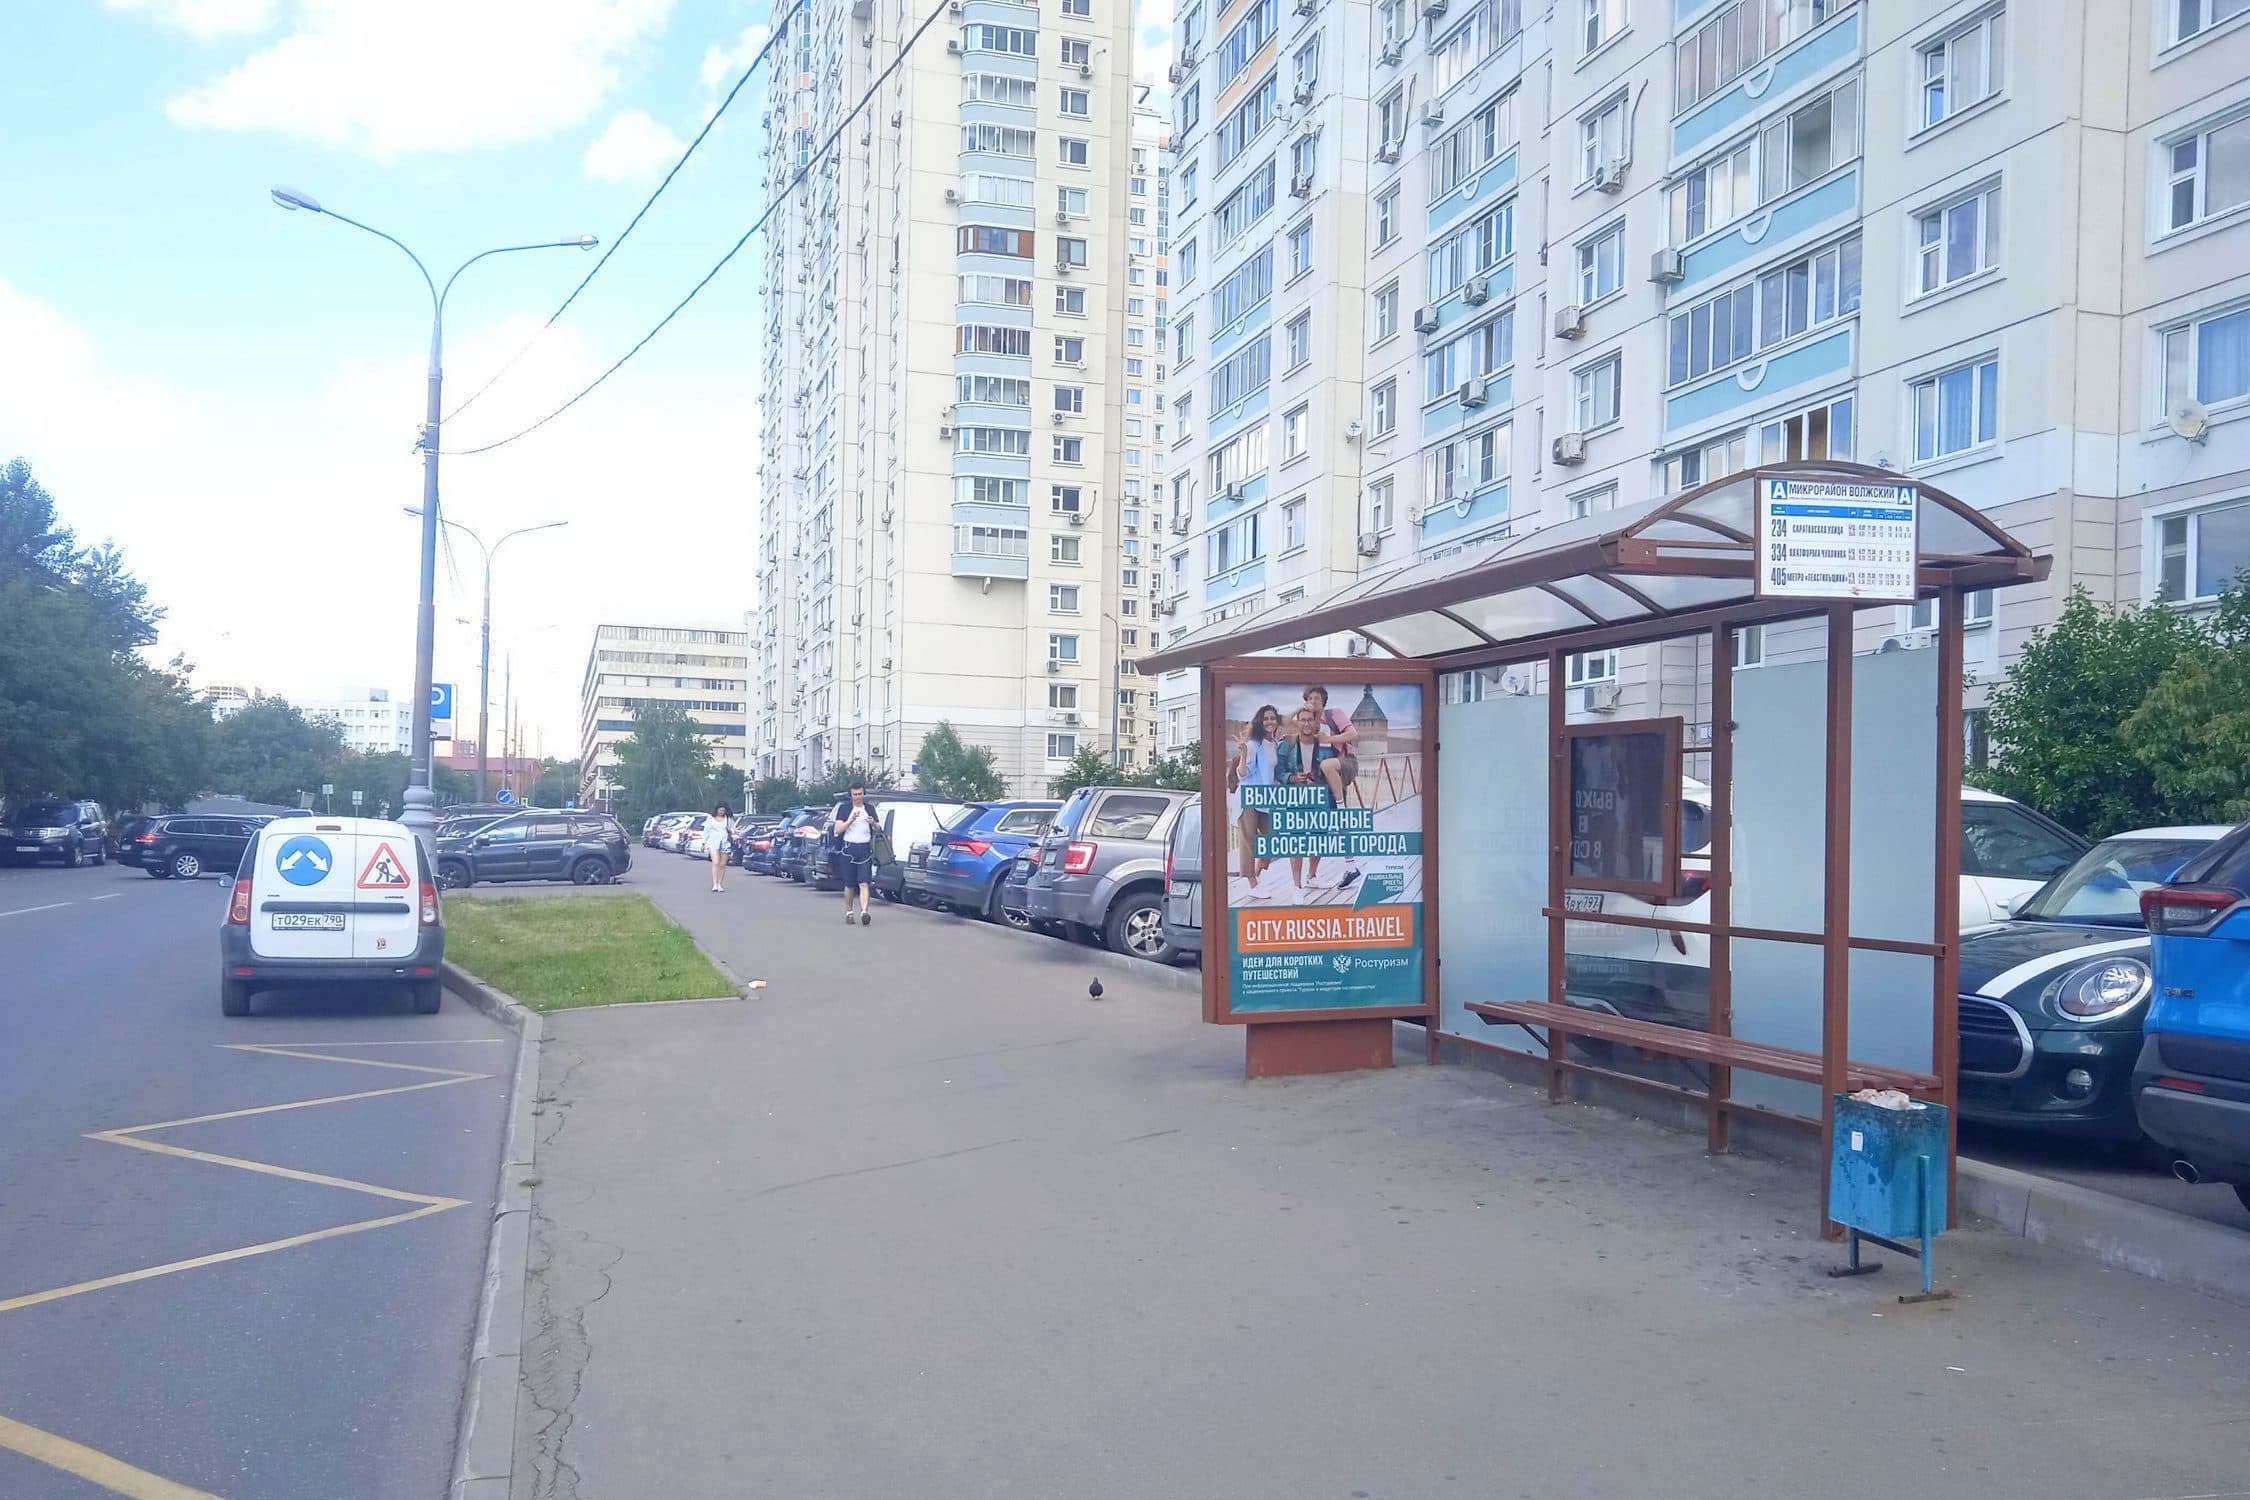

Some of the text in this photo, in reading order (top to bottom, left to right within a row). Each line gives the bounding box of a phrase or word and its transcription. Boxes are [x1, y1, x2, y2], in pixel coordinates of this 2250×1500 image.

[1789, 483, 1895, 499] МИКРОРАЙОН ВОЛЖСКИЙ
[1771, 519, 1787, 537] 234
[1771, 543, 1787, 562] 334
[1770, 567, 1787, 586] 405
[1787, 572, 1804, 582] МЕТРО
[1245, 786, 1326, 807] ВЫХОДИТЕ
[1273, 810, 1372, 831] В ВЫХОДНЫЕ
[1257, 834, 1407, 856] В СОСЕДНИЕ ГОРОДА
[1246, 916, 1405, 941] CITY.RUSSIA.TRAVEL
[1242, 955, 1324, 969] ИДЕИ ДЛЯ КОРОТКИХ
[1354, 958, 1409, 970] Ростуризм
[1242, 967, 1299, 981] ПУТЕШЕСТВИЙ
